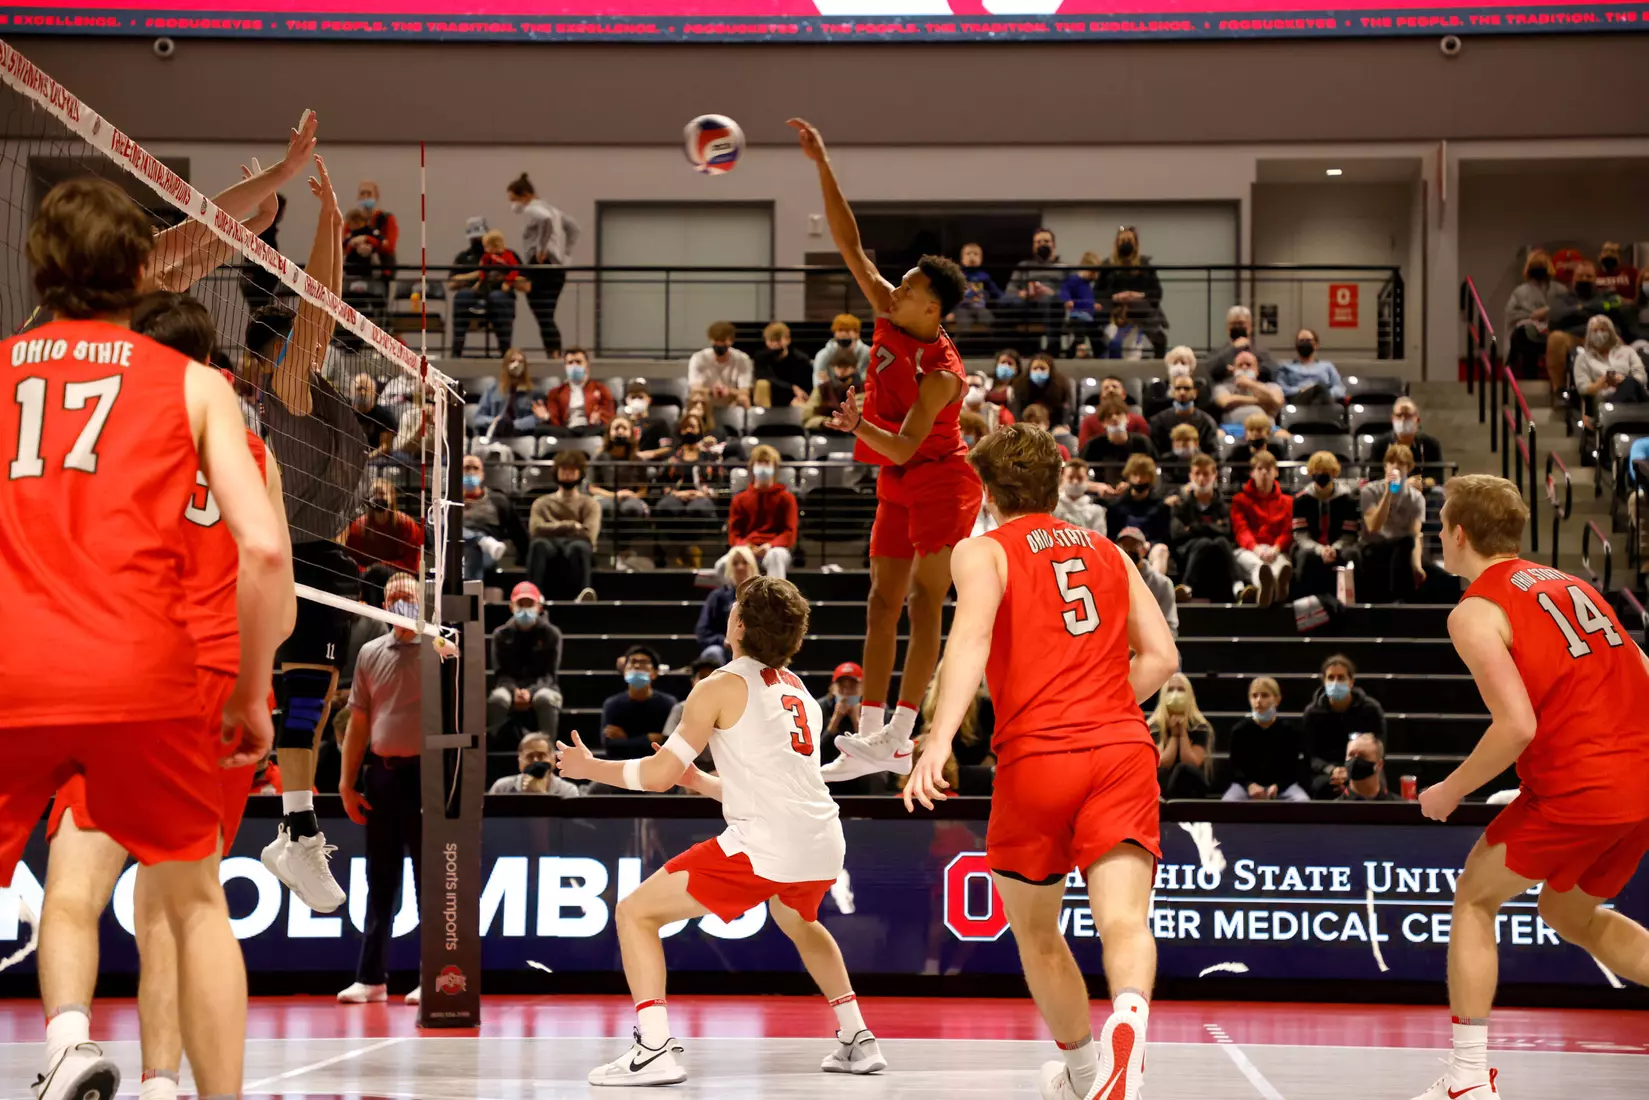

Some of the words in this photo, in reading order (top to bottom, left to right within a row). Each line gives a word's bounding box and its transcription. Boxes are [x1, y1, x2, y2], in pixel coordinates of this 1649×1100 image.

[286, 20, 317, 31] THE
[321, 21, 388, 32] PEOPLE.
[392, 22, 423, 32] THE
[426, 22, 517, 33] TRADITION.
[521, 22, 552, 34] THE
[820, 24, 851, 34] THE
[925, 23, 956, 34] THE
[1055, 22, 1087, 33] THE
[1360, 16, 1392, 28] THE
[1396, 15, 1464, 28] PEOPLE.
[1469, 14, 1500, 26] THE
[1506, 12, 1600, 25] TRADITION.
[1605, 11, 1637, 22] THE
[11, 338, 68, 367] OHIO
[73, 340, 134, 367] STATE
[8, 373, 124, 481] 17
[1026, 528, 1054, 555] OHIO
[1052, 528, 1096, 551] STATE
[1050, 557, 1101, 637] 5
[1510, 570, 1538, 592] OHIO
[1536, 585, 1624, 659] 14
[325, 642, 336, 660] 11
[780, 694, 814, 757] 3
[443, 842, 458, 890] sports
[1157, 863, 1223, 891] HIO
[1234, 859, 1351, 892] STATE
[443, 892, 458, 951] imports
[1213, 911, 1389, 942] MEDICAL
[1402, 912, 1561, 945] CETER
